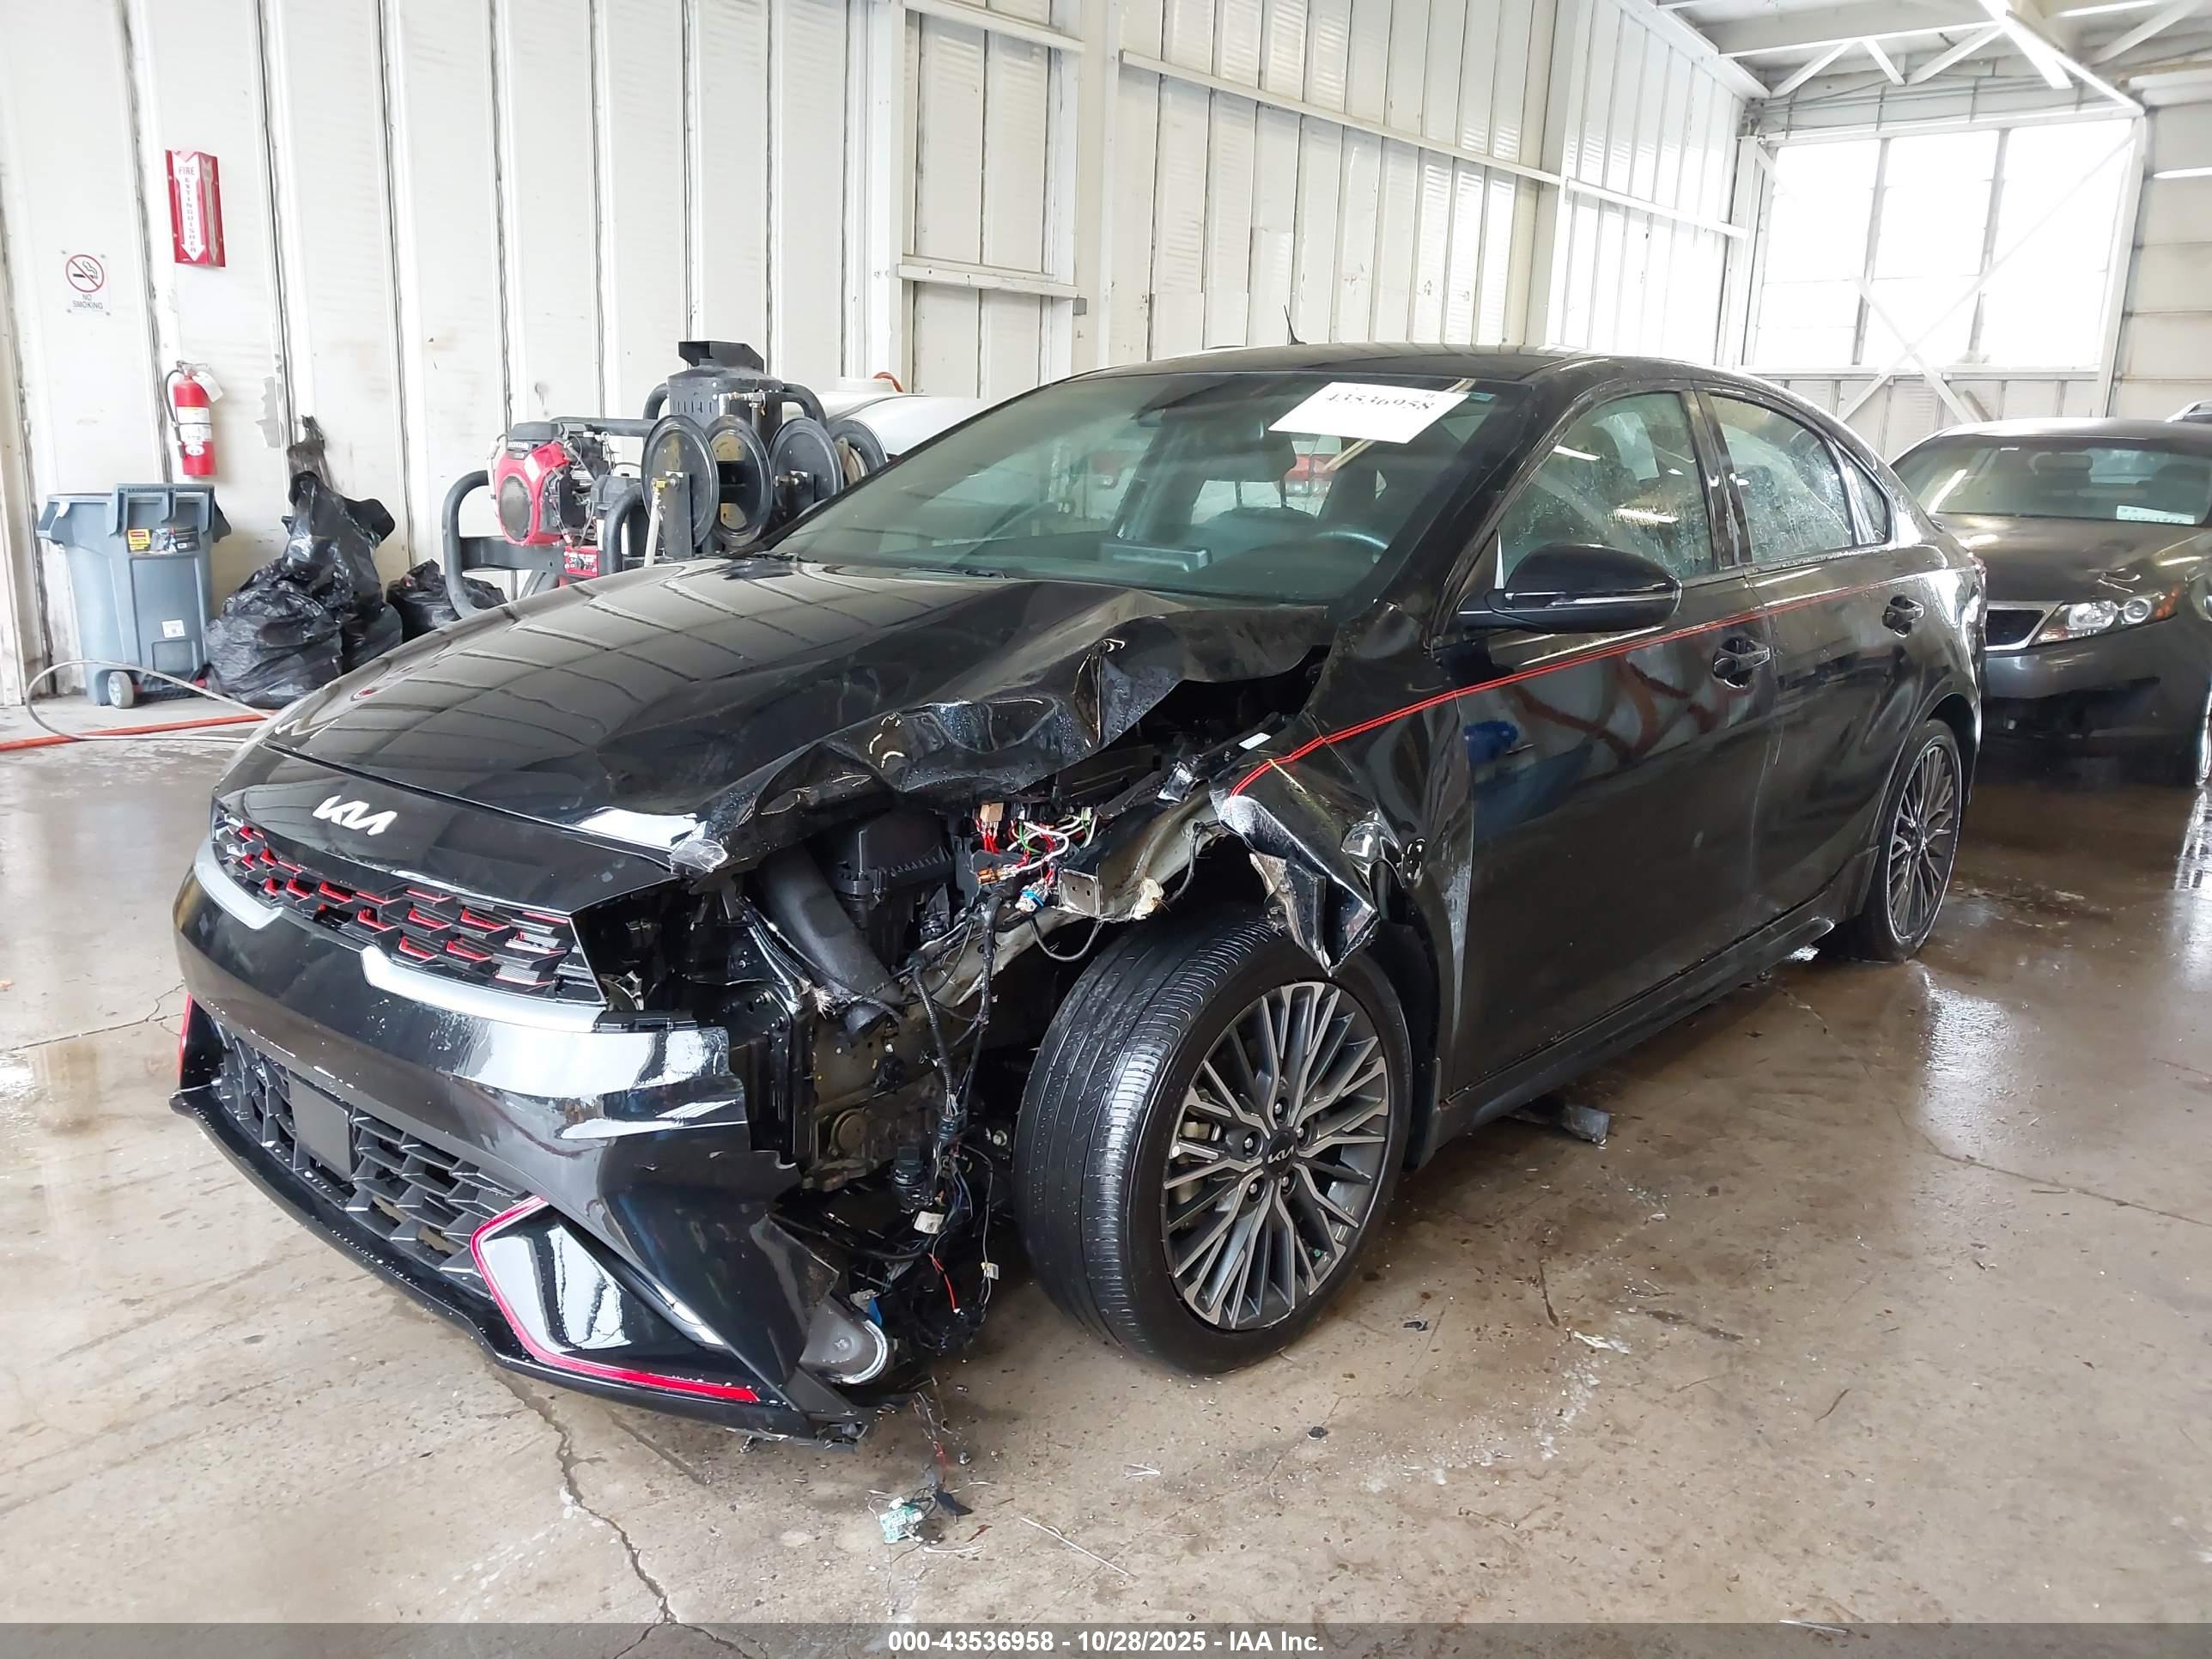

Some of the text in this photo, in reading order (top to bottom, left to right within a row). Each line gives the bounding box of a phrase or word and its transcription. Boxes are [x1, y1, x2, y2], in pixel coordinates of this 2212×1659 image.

[178, 166, 196, 176] FIRE
[184, 177, 198, 252] EXTINGUISHER
[72, 301, 104, 310] SMOKING
